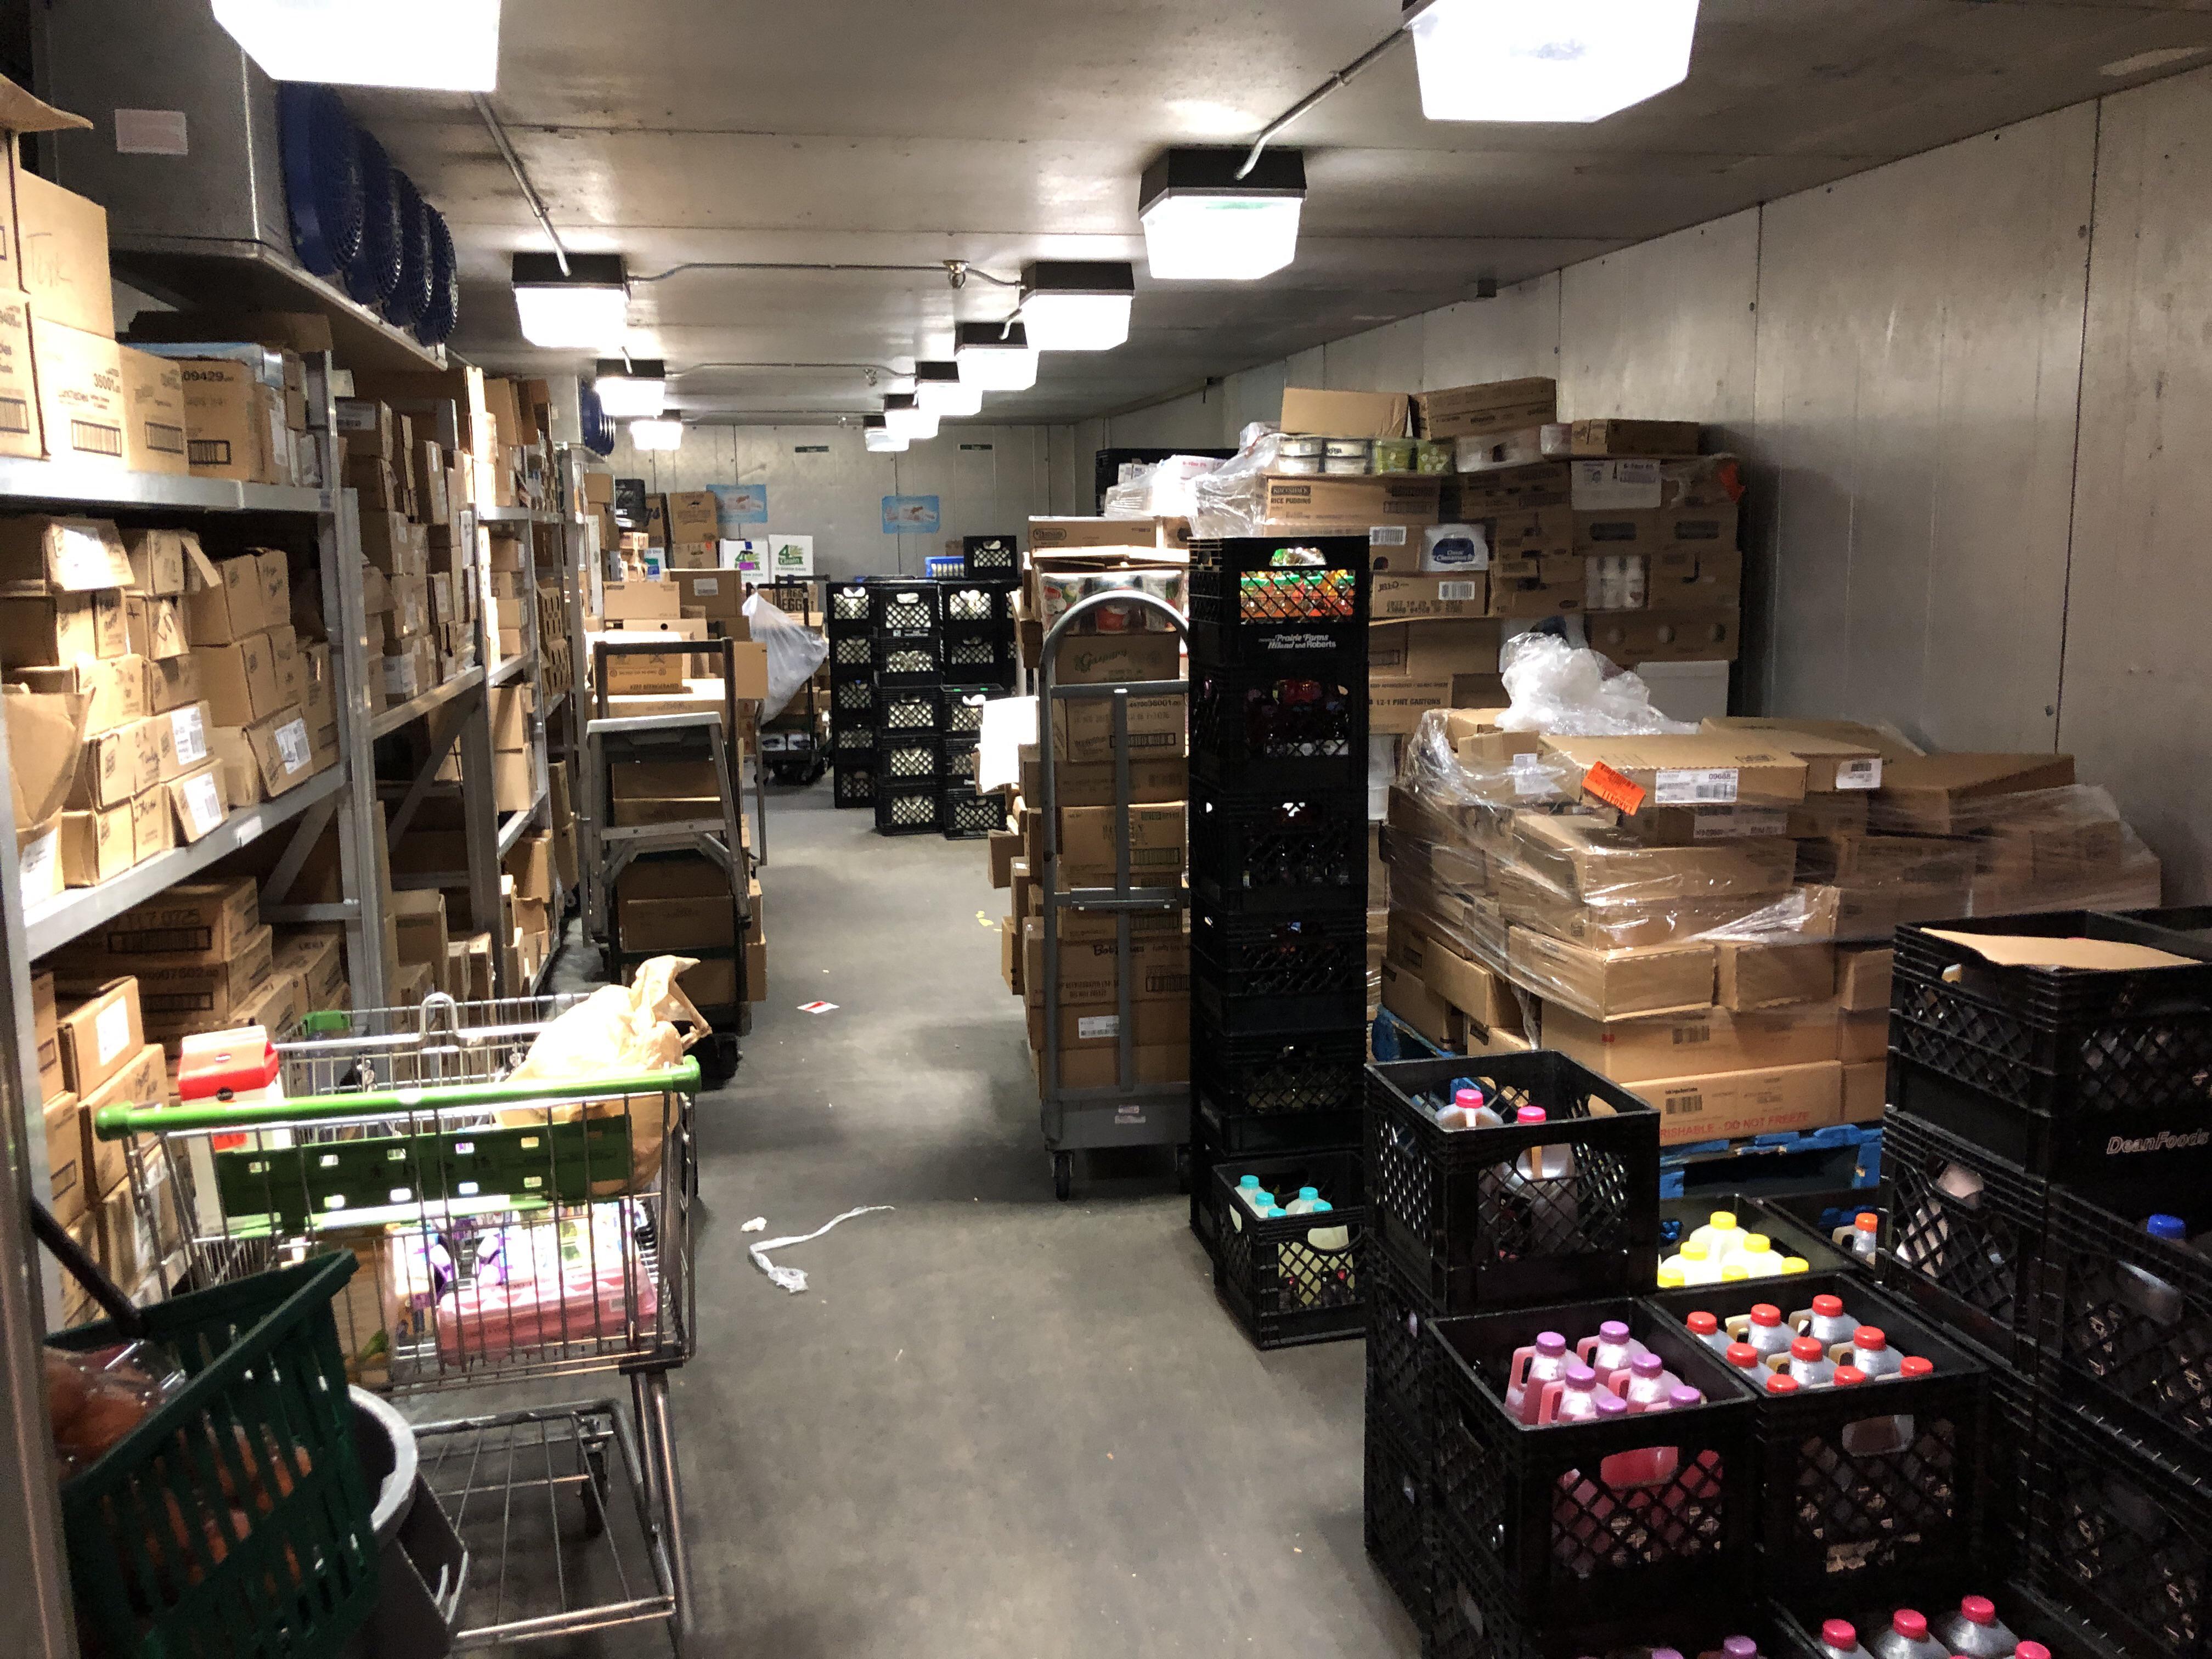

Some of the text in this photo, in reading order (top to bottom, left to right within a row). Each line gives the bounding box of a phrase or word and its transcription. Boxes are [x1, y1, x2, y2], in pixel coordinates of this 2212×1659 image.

[782, 588, 803, 597] FRES
[782, 599, 803, 612] EGG
[1660, 1124, 1713, 1137] RISHABLE
[1725, 1120, 1740, 1131] DO
[1743, 1118, 1764, 1128] NOT
[1768, 1111, 1809, 1125] FREEZE
